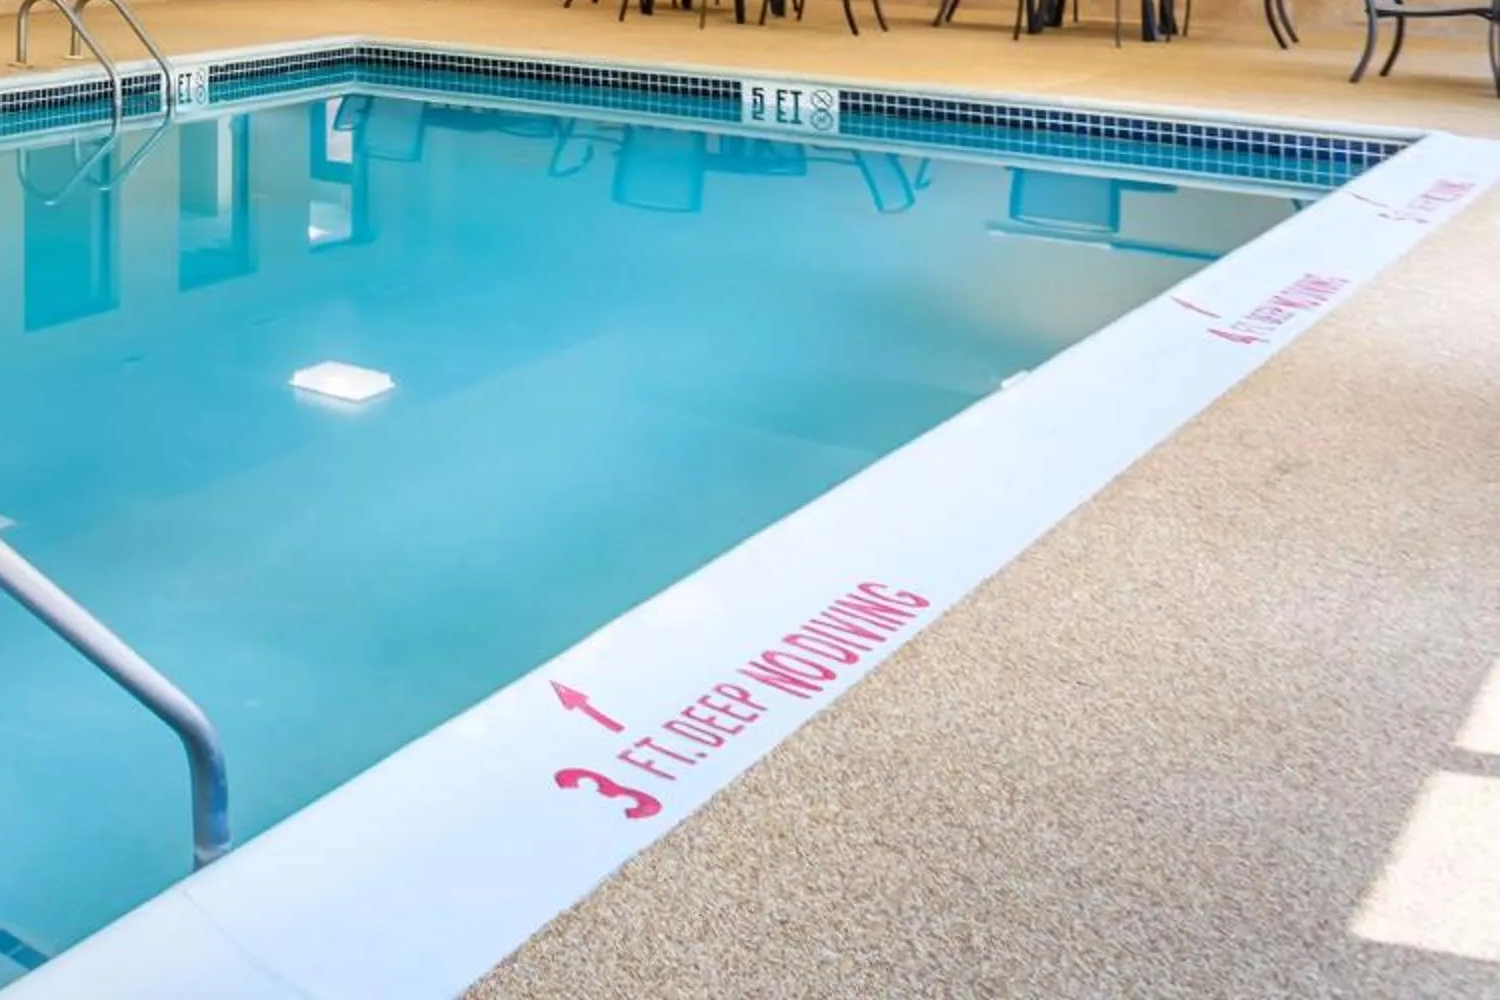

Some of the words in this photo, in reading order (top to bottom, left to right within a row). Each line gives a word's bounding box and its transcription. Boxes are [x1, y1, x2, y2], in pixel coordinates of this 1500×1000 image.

[776, 89, 803, 108] FT
[553, 767, 663, 819] 3
[781, 582, 931, 665] DIVING
